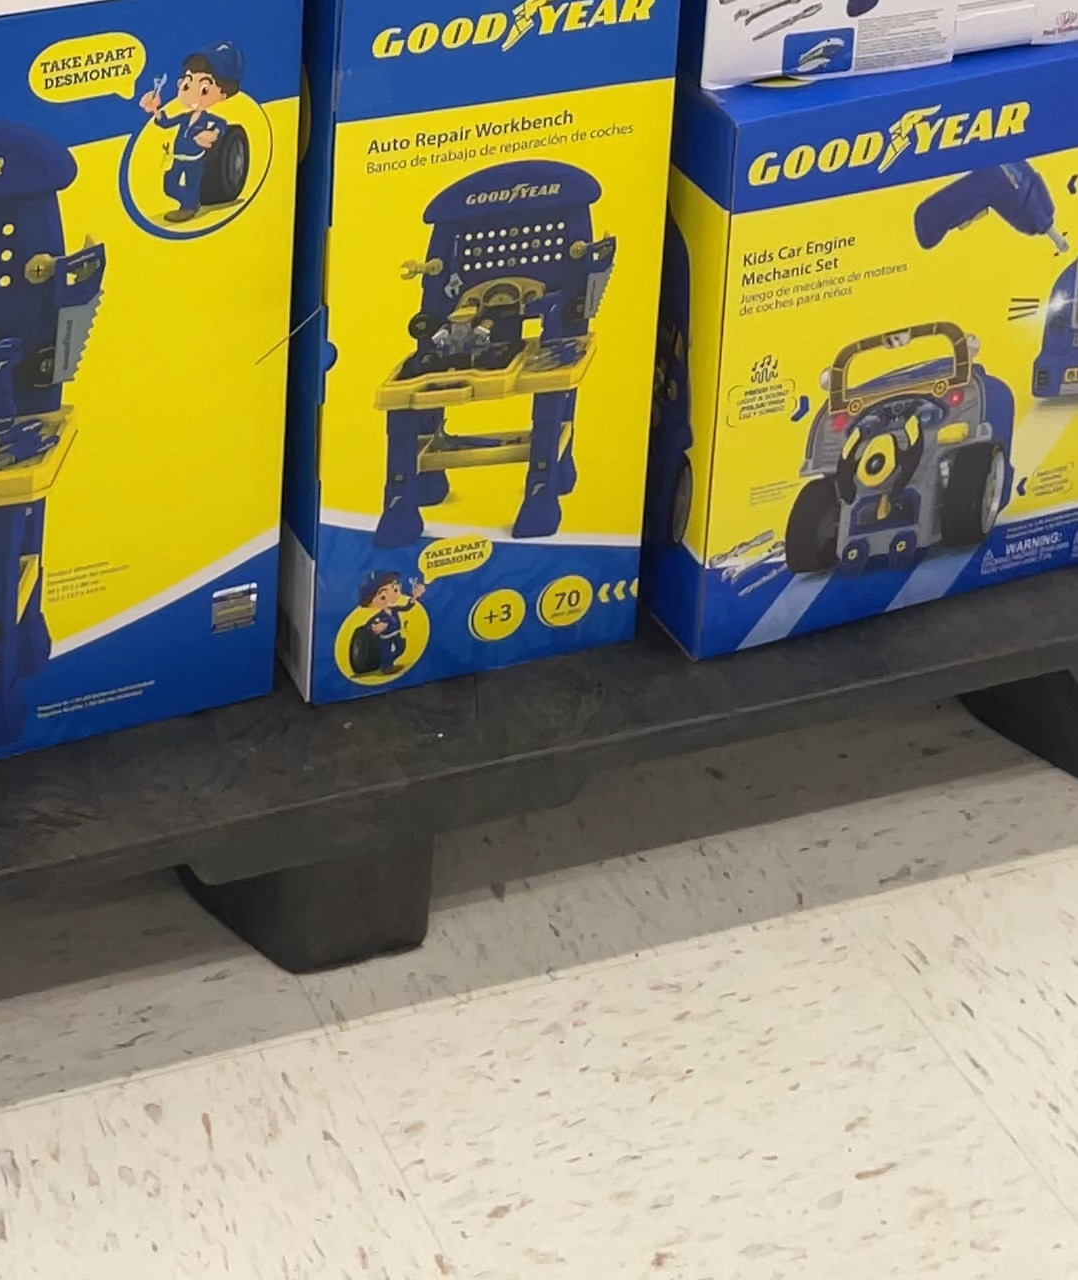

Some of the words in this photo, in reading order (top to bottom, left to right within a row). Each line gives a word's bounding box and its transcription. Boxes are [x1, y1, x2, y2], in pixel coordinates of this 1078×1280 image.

[39, 54, 80, 76] TAKE
[83, 45, 137, 70] APART
[43, 62, 133, 90] DESMONTA
[367, 138, 411, 156] Auto
[415, 126, 471, 149] Repair
[475, 109, 574, 138] Workbench
[748, 102, 1032, 187] GOODYEAR
[366, 160, 407, 175] Banco
[410, 155, 427, 168] de
[430, 148, 477, 168] trabajo
[480, 144, 497, 157] de
[499, 133, 568, 155] reparación
[571, 129, 587, 142] de
[590, 122, 634, 140] coches
[465, 183, 562, 206] GOODYEAR
[743, 251, 774, 267] Kids
[778, 246, 803, 261] Car
[806, 235, 856, 257] Engine
[741, 264, 812, 287] Mechanic
[816, 257, 839, 272] Set
[864, 262, 908, 280] motores
[756, 296, 794, 313] coches
[1005, 531, 1063, 555] WARNING:
[426, 550, 484, 569] DESMONTA
[484, 603, 513, 624] +3
[555, 590, 581, 611] 70
